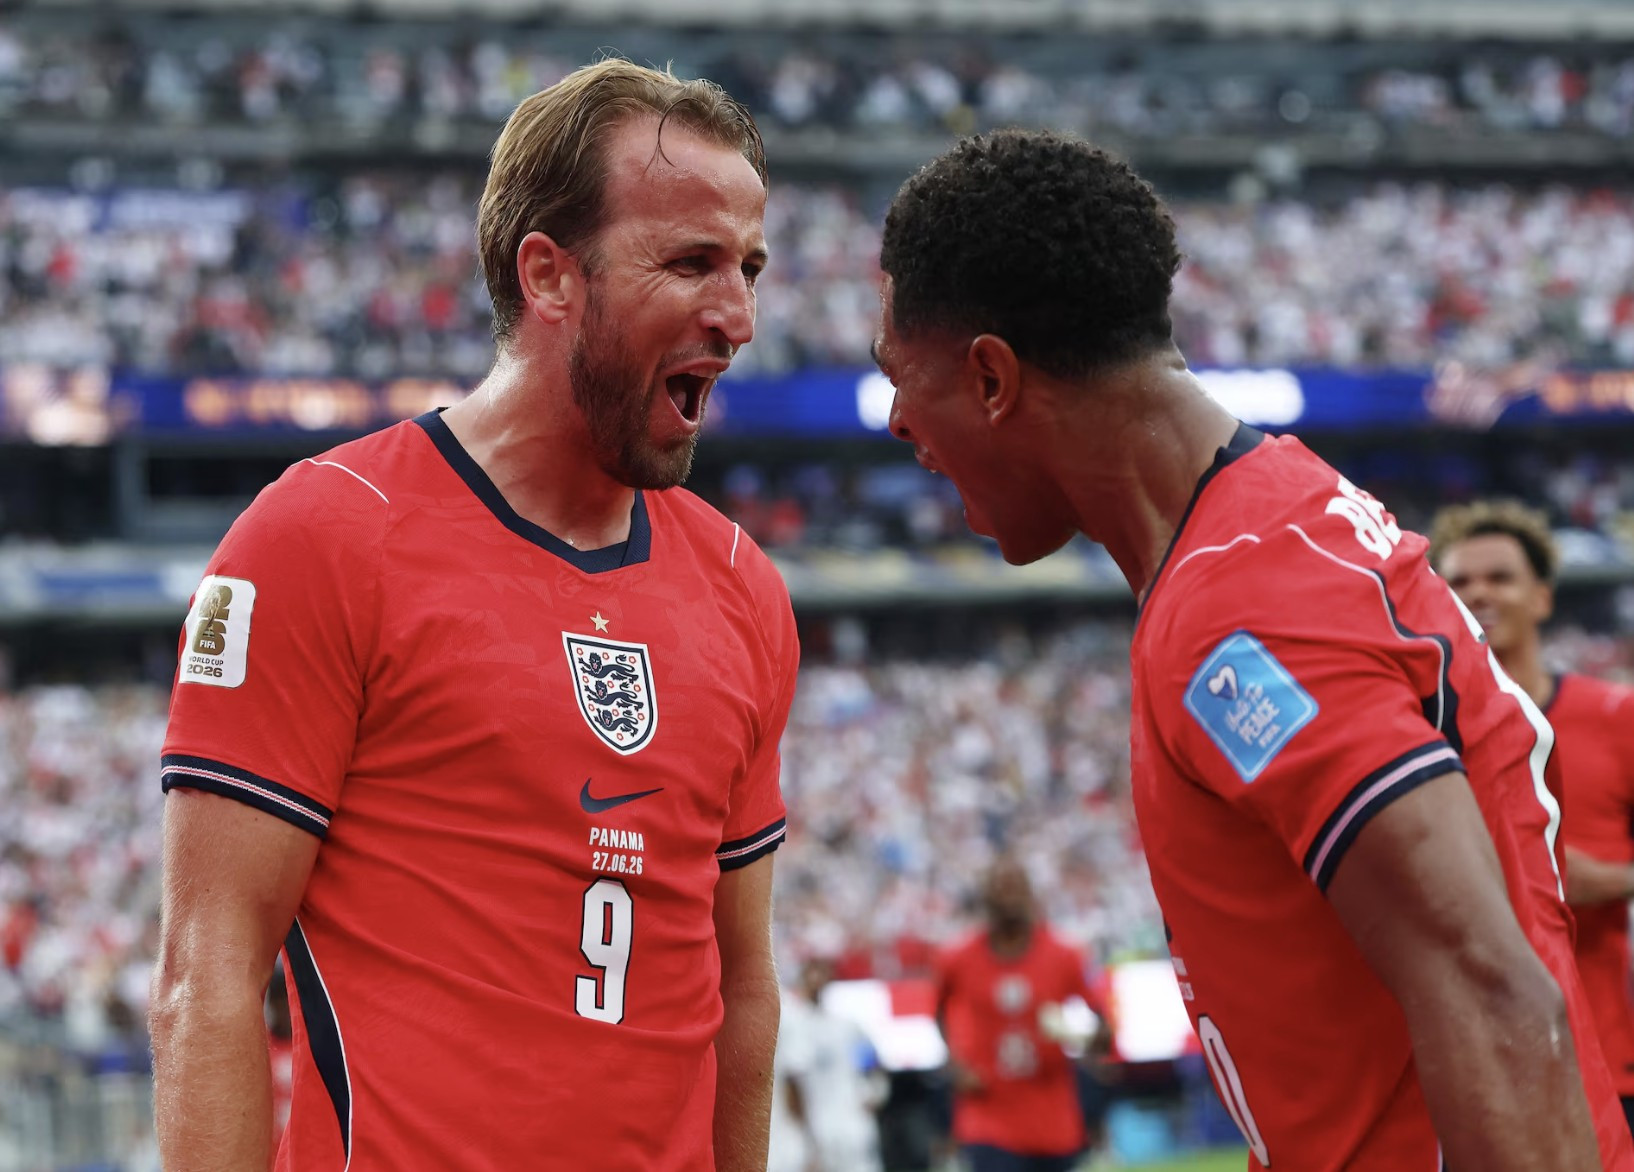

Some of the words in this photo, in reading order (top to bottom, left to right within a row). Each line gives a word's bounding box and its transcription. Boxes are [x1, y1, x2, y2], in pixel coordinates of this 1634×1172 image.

[200, 640, 216, 649] FIFA
[187, 664, 223, 677] 2026
[589, 827, 644, 851] PANAMA
[592, 851, 643, 875] 27.06.26
[575, 876, 633, 1024] 9
